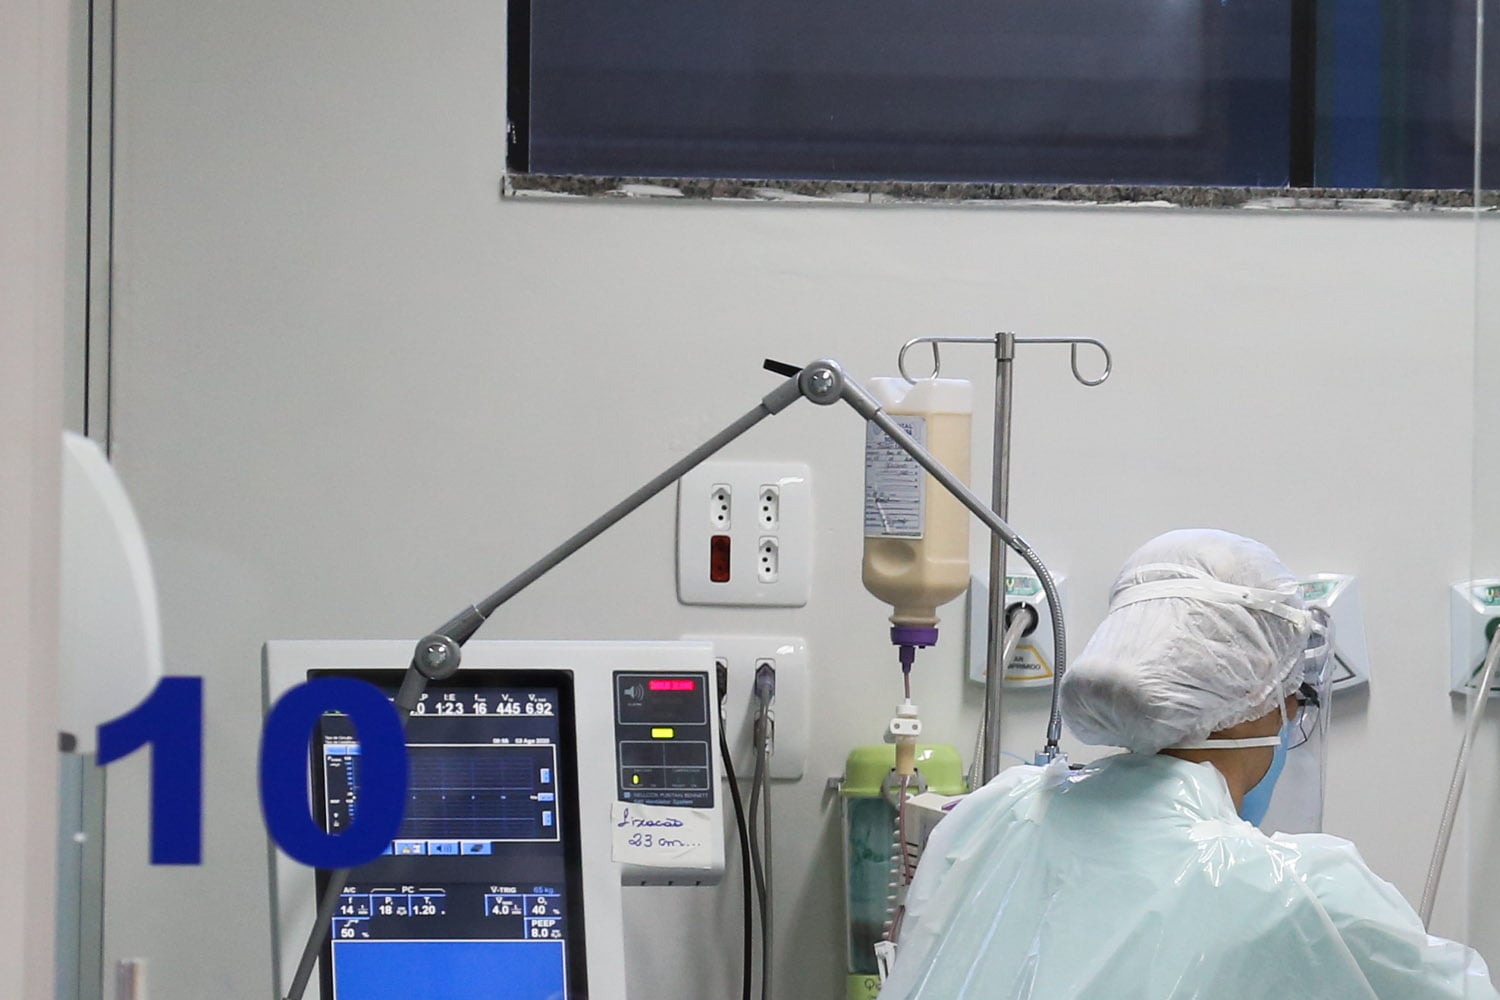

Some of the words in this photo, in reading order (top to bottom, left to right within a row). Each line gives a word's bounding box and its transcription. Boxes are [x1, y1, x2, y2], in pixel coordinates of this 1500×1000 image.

[472, 702, 487, 714] 16
[496, 702, 521, 714] 445
[525, 702, 552, 714] 6.92
[95, 675, 408, 870] 10
[628, 833, 653, 848] 23
[401, 885, 415, 893] PC
[340, 905, 354, 915] 14
[379, 905, 393, 915] 18
[412, 905, 436, 915] 1.20
[492, 905, 509, 915] 4.0
[531, 905, 546, 915] 40
[340, 928, 355, 938] 50
[531, 928, 549, 938] 8.0
